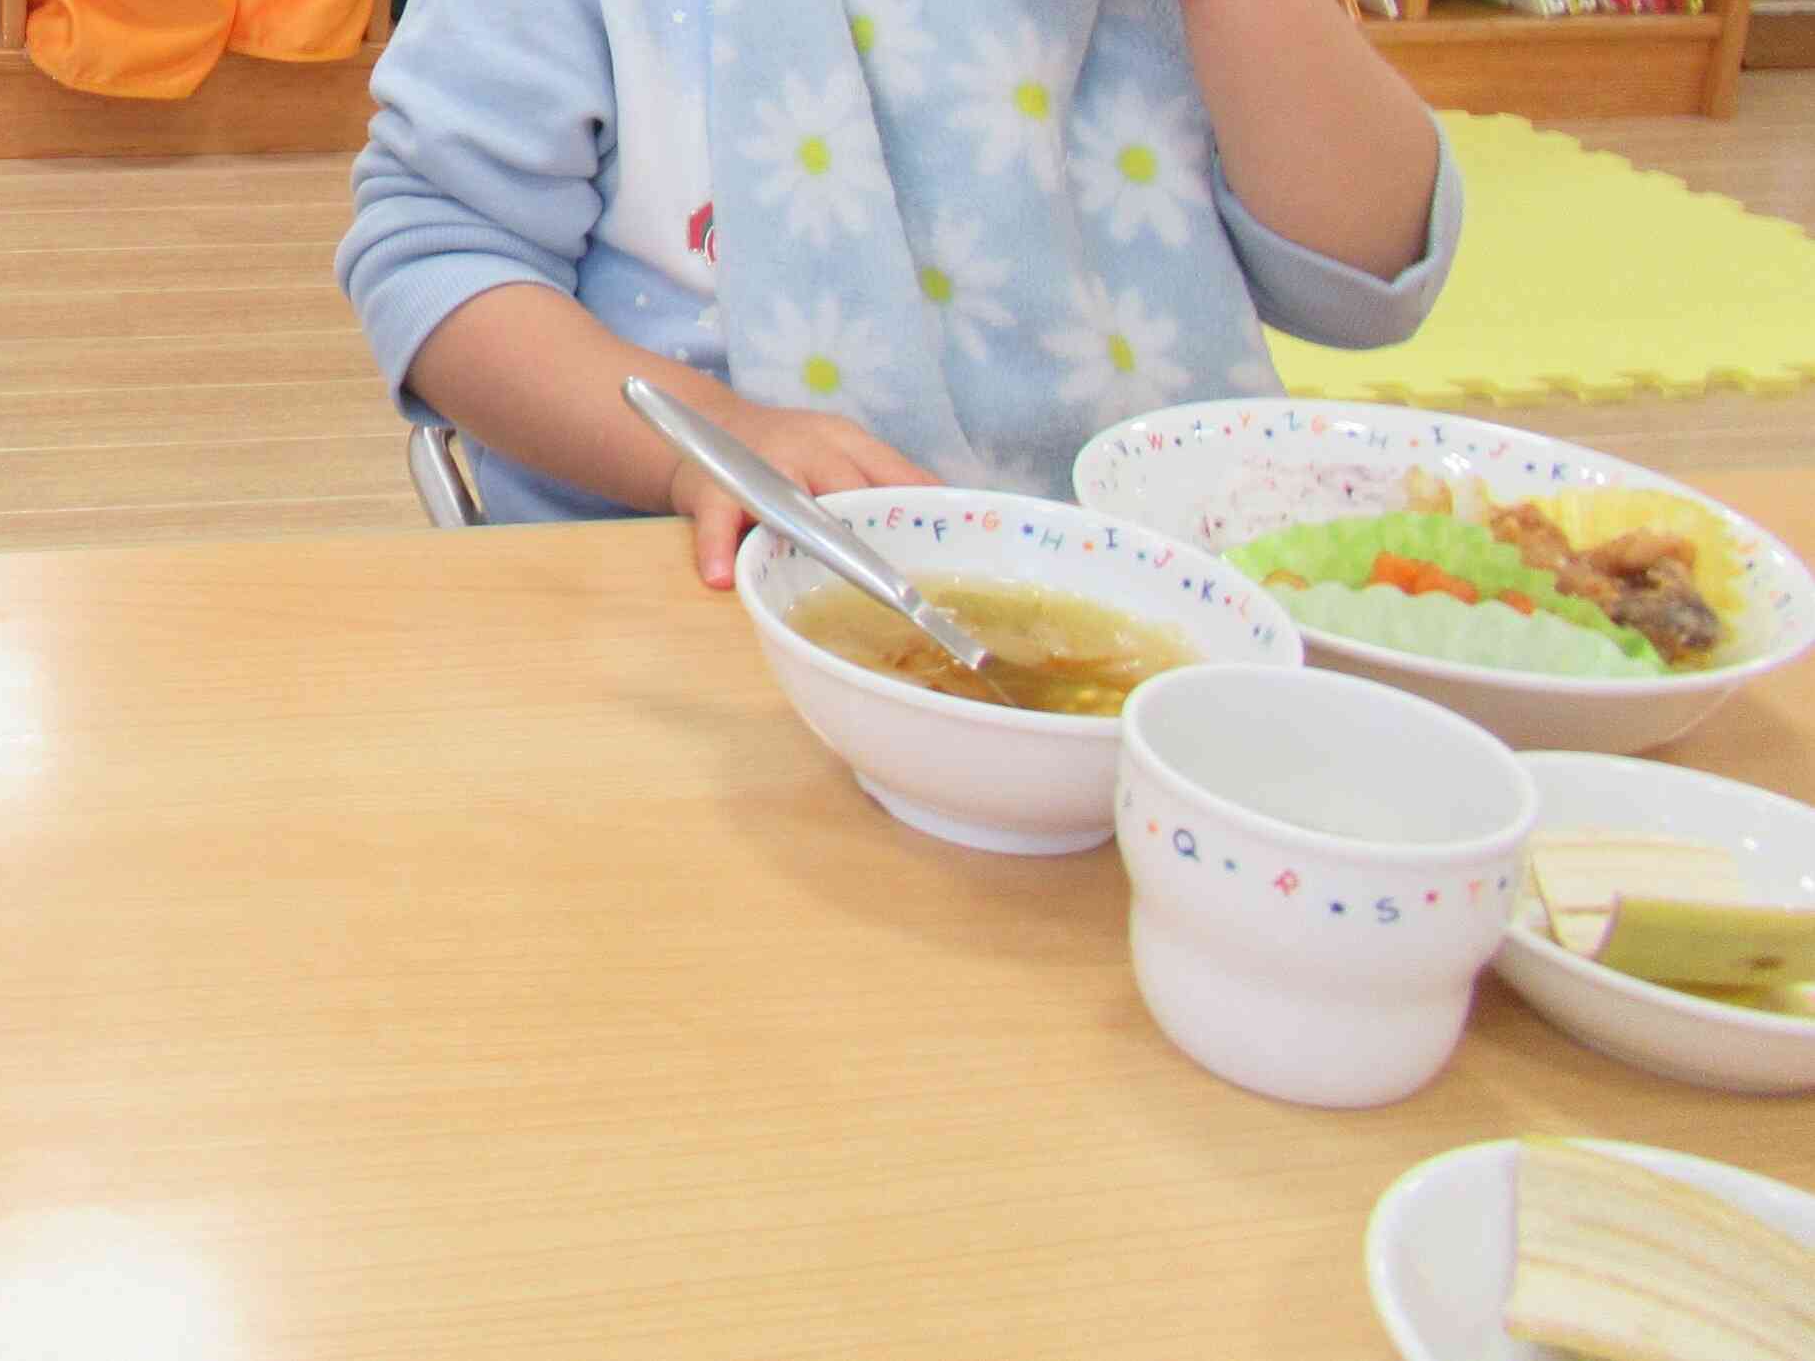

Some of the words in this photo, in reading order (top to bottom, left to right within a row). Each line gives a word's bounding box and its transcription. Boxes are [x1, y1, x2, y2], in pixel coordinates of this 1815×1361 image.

[933, 518, 948, 543] F
[1172, 827, 1201, 863] Q
[1375, 896, 1401, 924] S
